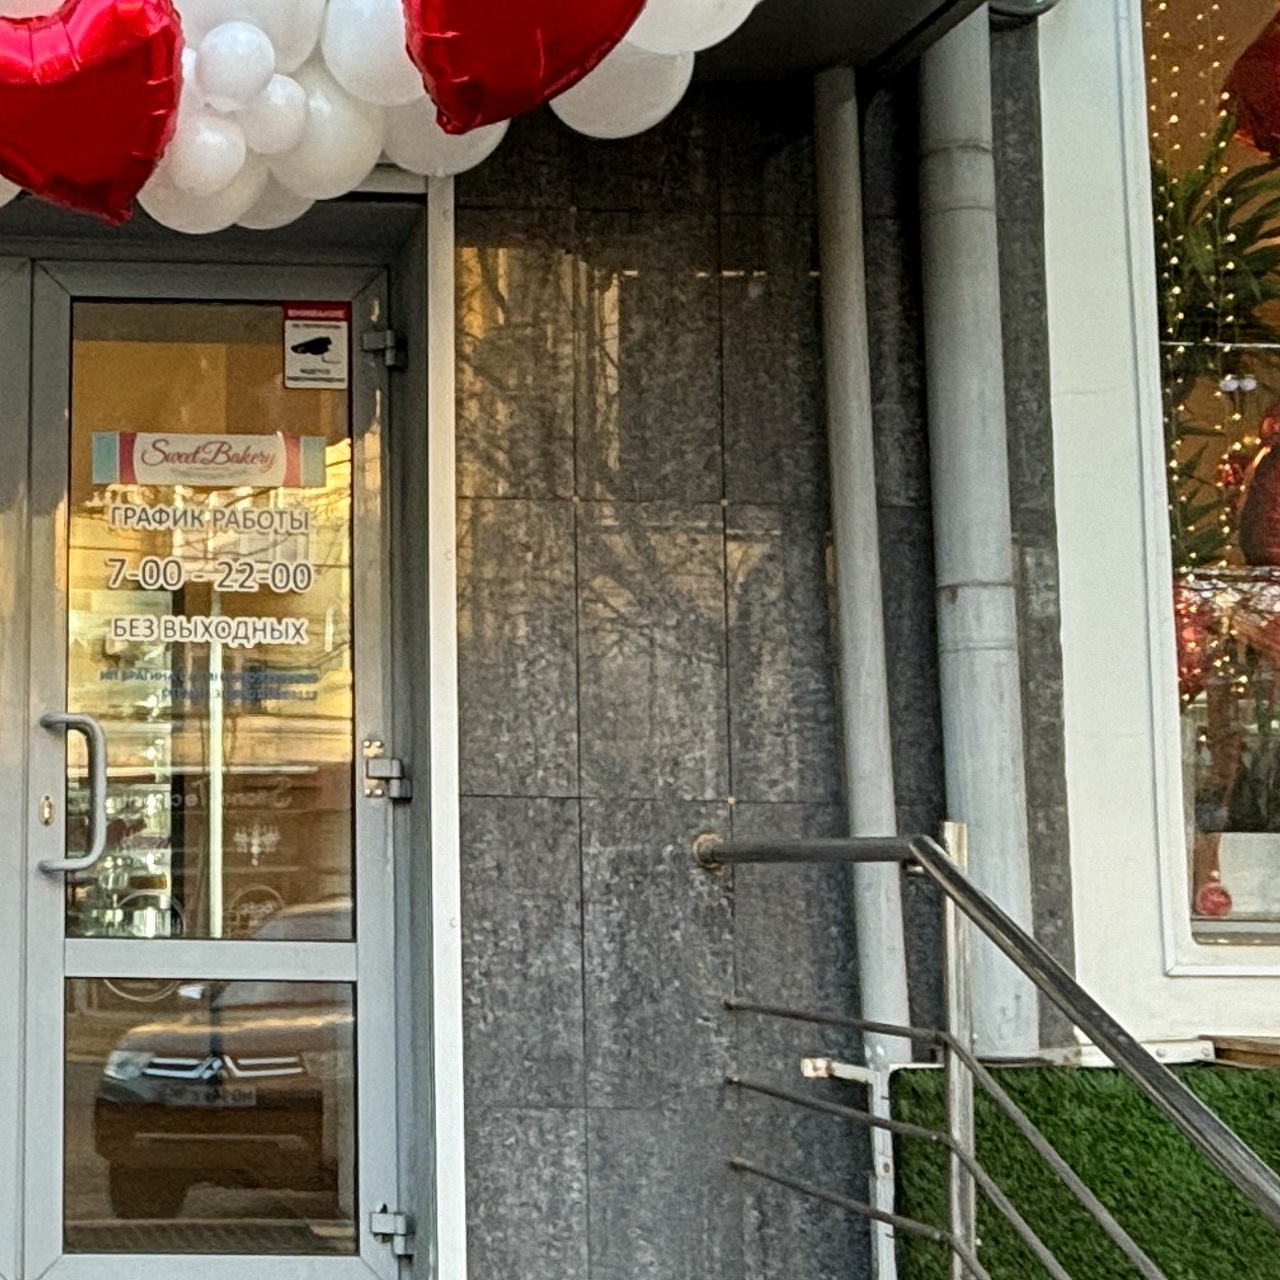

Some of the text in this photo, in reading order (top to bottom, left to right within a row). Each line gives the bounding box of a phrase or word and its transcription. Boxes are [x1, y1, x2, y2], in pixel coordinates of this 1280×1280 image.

[140, 438, 279, 471] Sweet Bakery
[110, 506, 310, 531] ГРАФИК РАБОТЫ
[106, 558, 183, 589] 7-00
[216, 560, 313, 591] 22-00
[113, 617, 305, 646] БЕЗ ВЫХОДНЫХ
